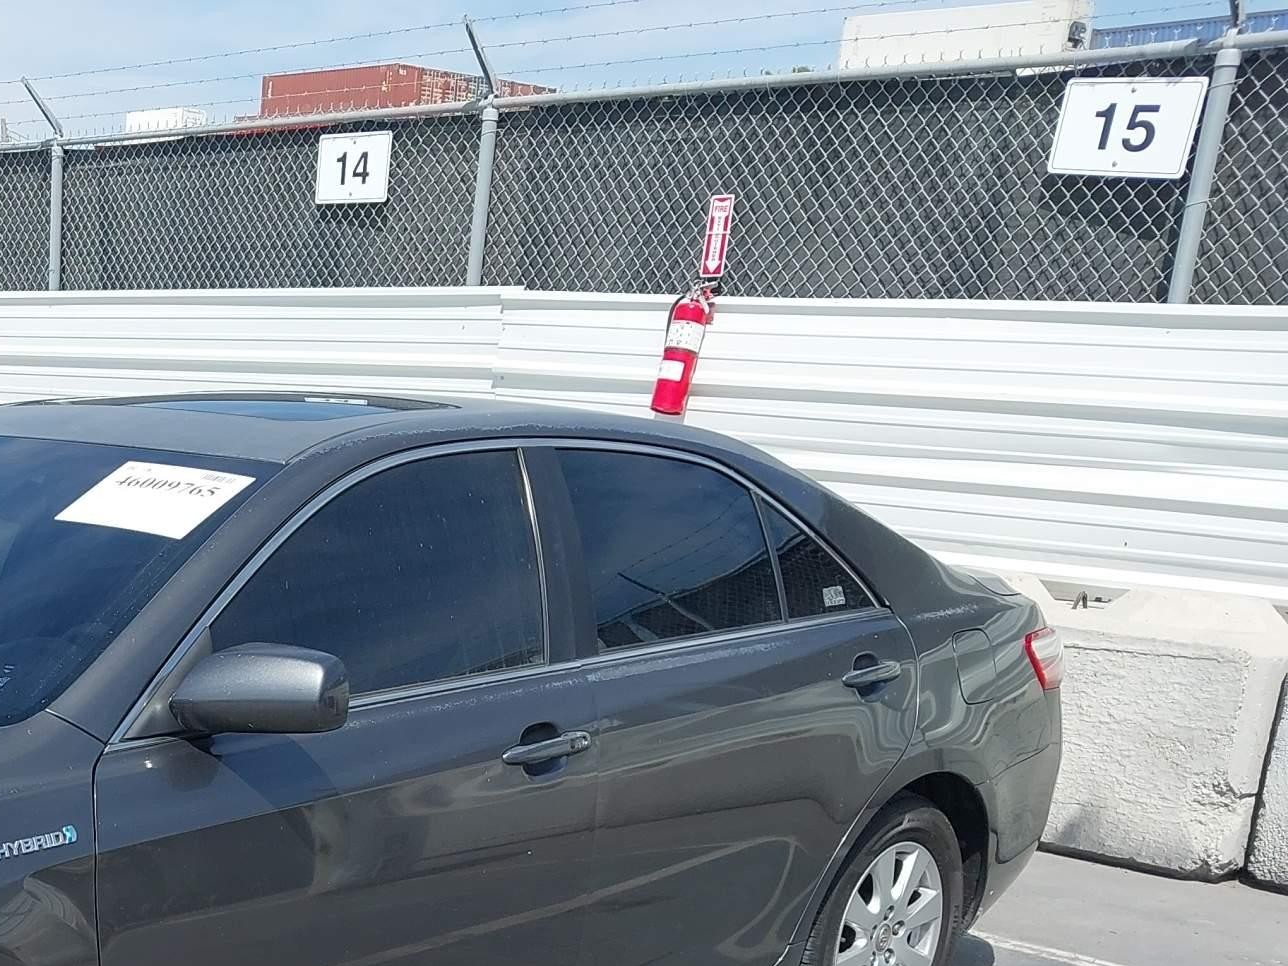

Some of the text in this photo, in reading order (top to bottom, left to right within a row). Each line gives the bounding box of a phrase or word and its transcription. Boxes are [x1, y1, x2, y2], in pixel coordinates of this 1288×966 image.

[1095, 102, 1161, 153] 15
[336, 151, 370, 186] 14
[115, 475, 221, 497] 46009765
